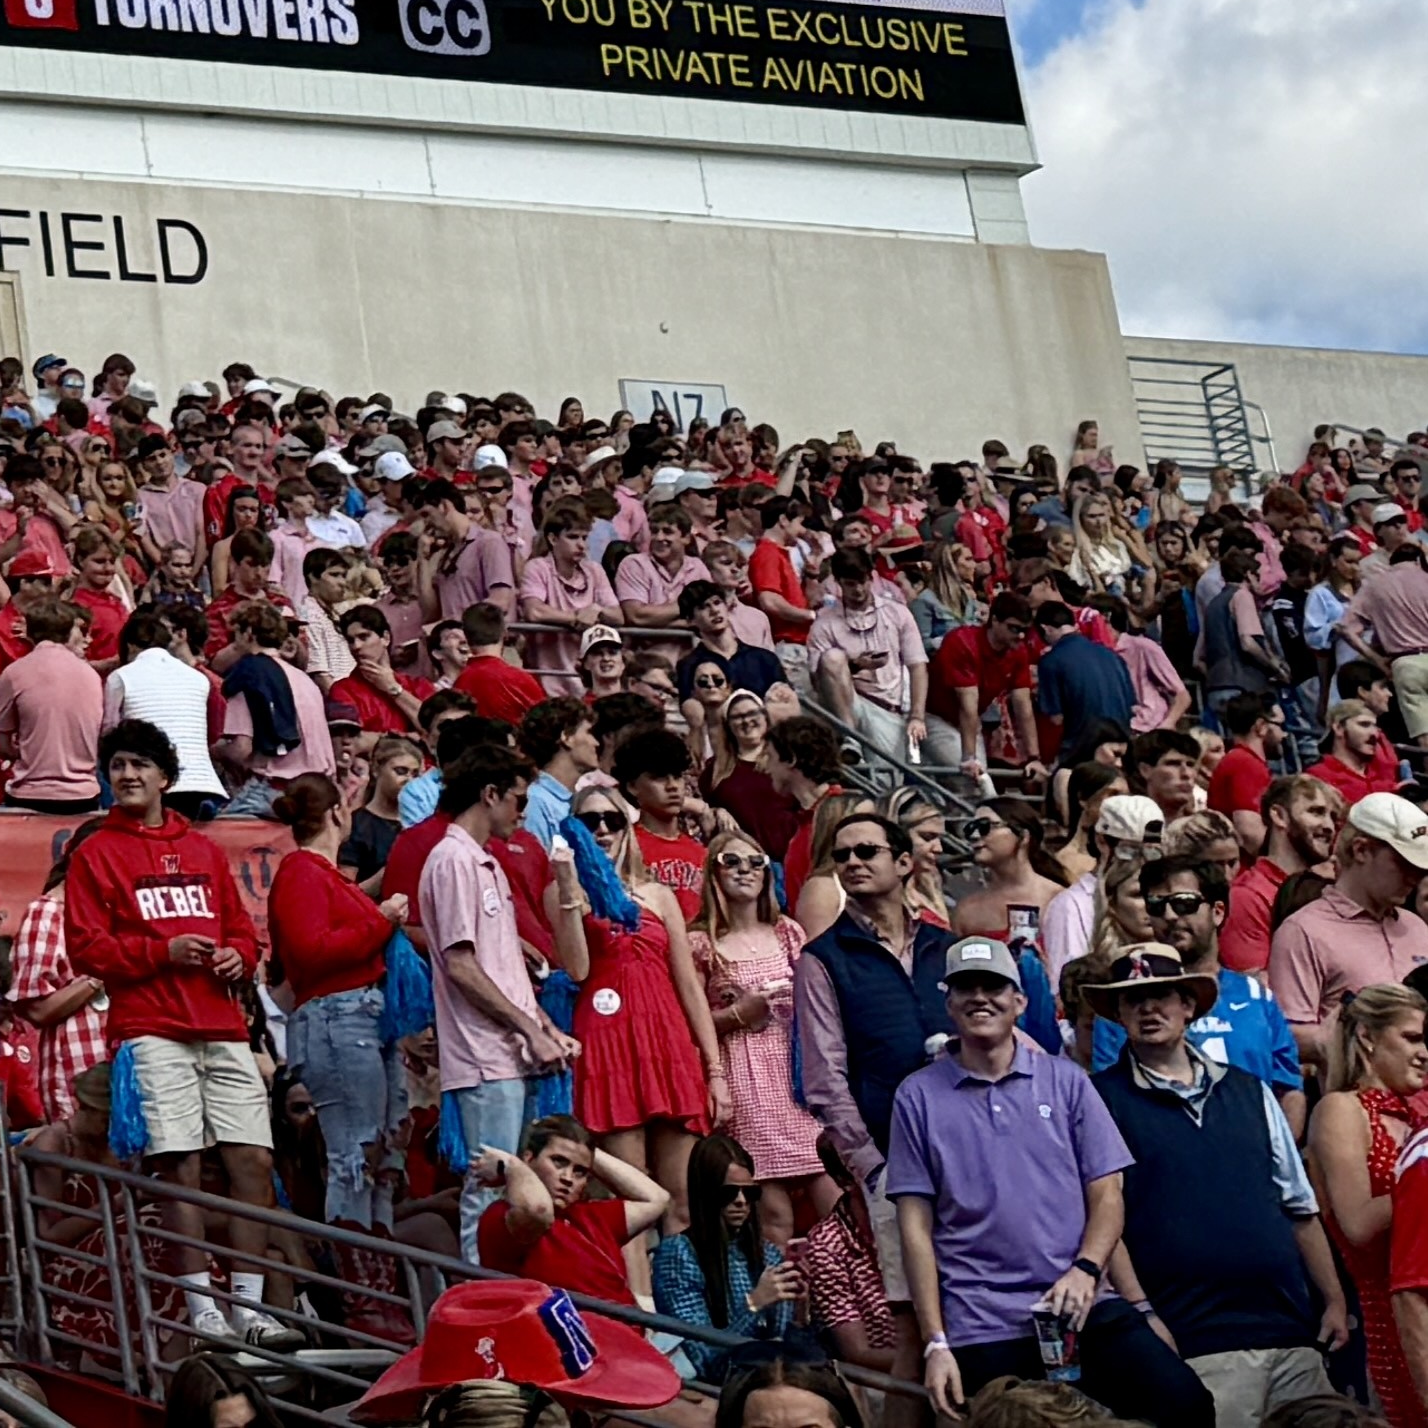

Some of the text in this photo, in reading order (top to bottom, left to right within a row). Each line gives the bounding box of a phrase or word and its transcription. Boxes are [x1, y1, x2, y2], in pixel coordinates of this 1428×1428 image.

[683, 0, 757, 40] THE
[766, 8, 969, 56] EXCLUSIVE
[601, 45, 925, 101] PRIVATE AVIATION
